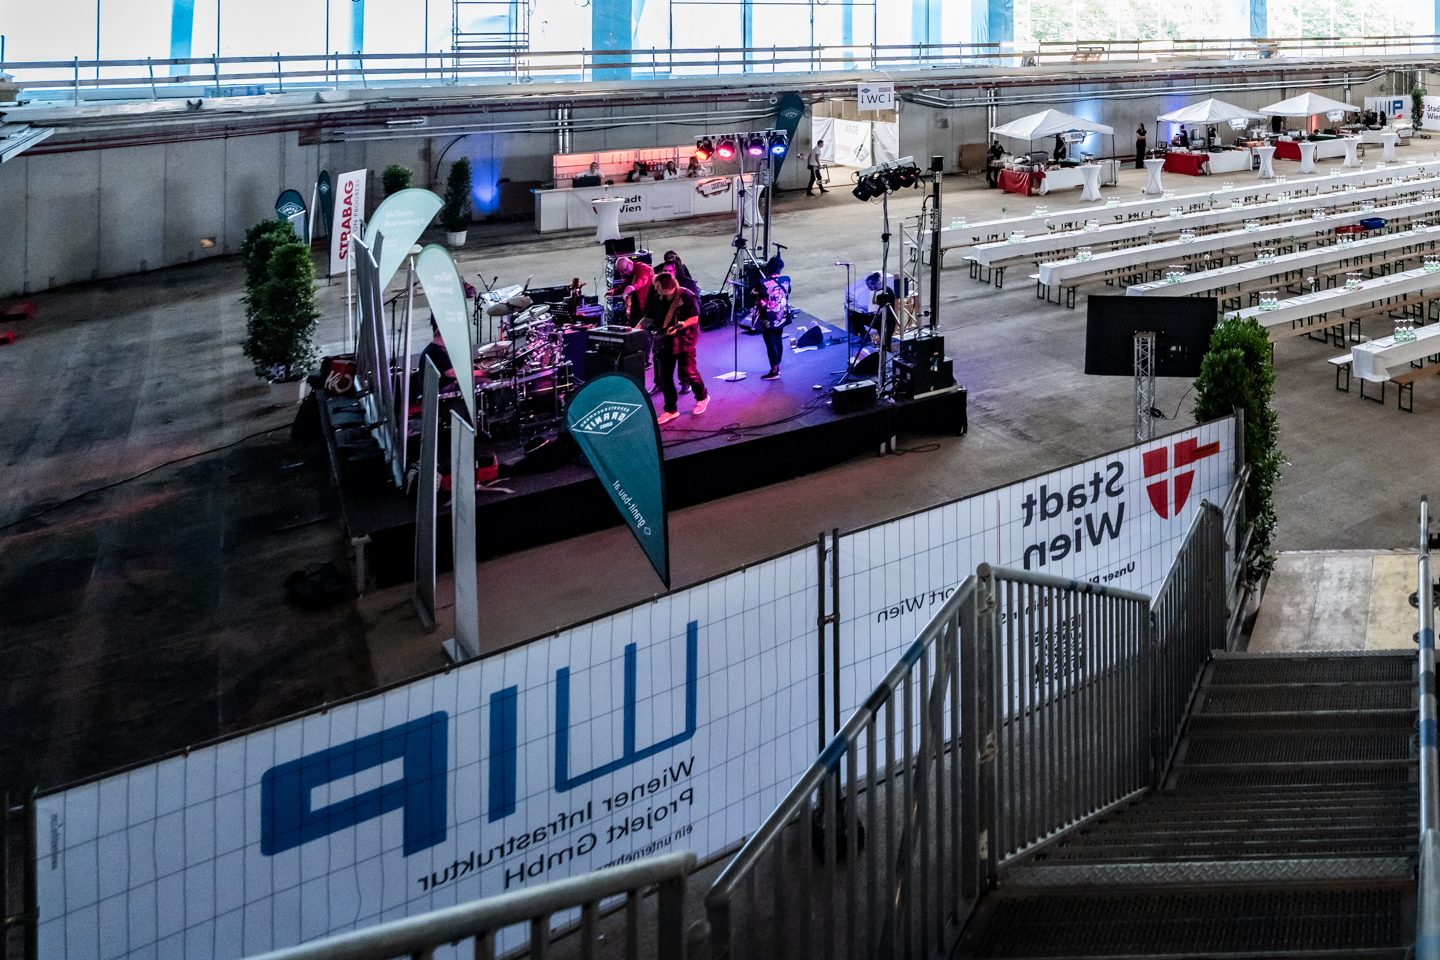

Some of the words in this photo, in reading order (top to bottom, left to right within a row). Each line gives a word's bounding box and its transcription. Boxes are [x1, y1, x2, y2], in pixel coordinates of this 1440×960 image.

[867, 94, 885, 103] WC
[385, 210, 413, 218] Wien
[339, 180, 354, 260] STRABAG
[384, 217, 428, 229] bewegt.
